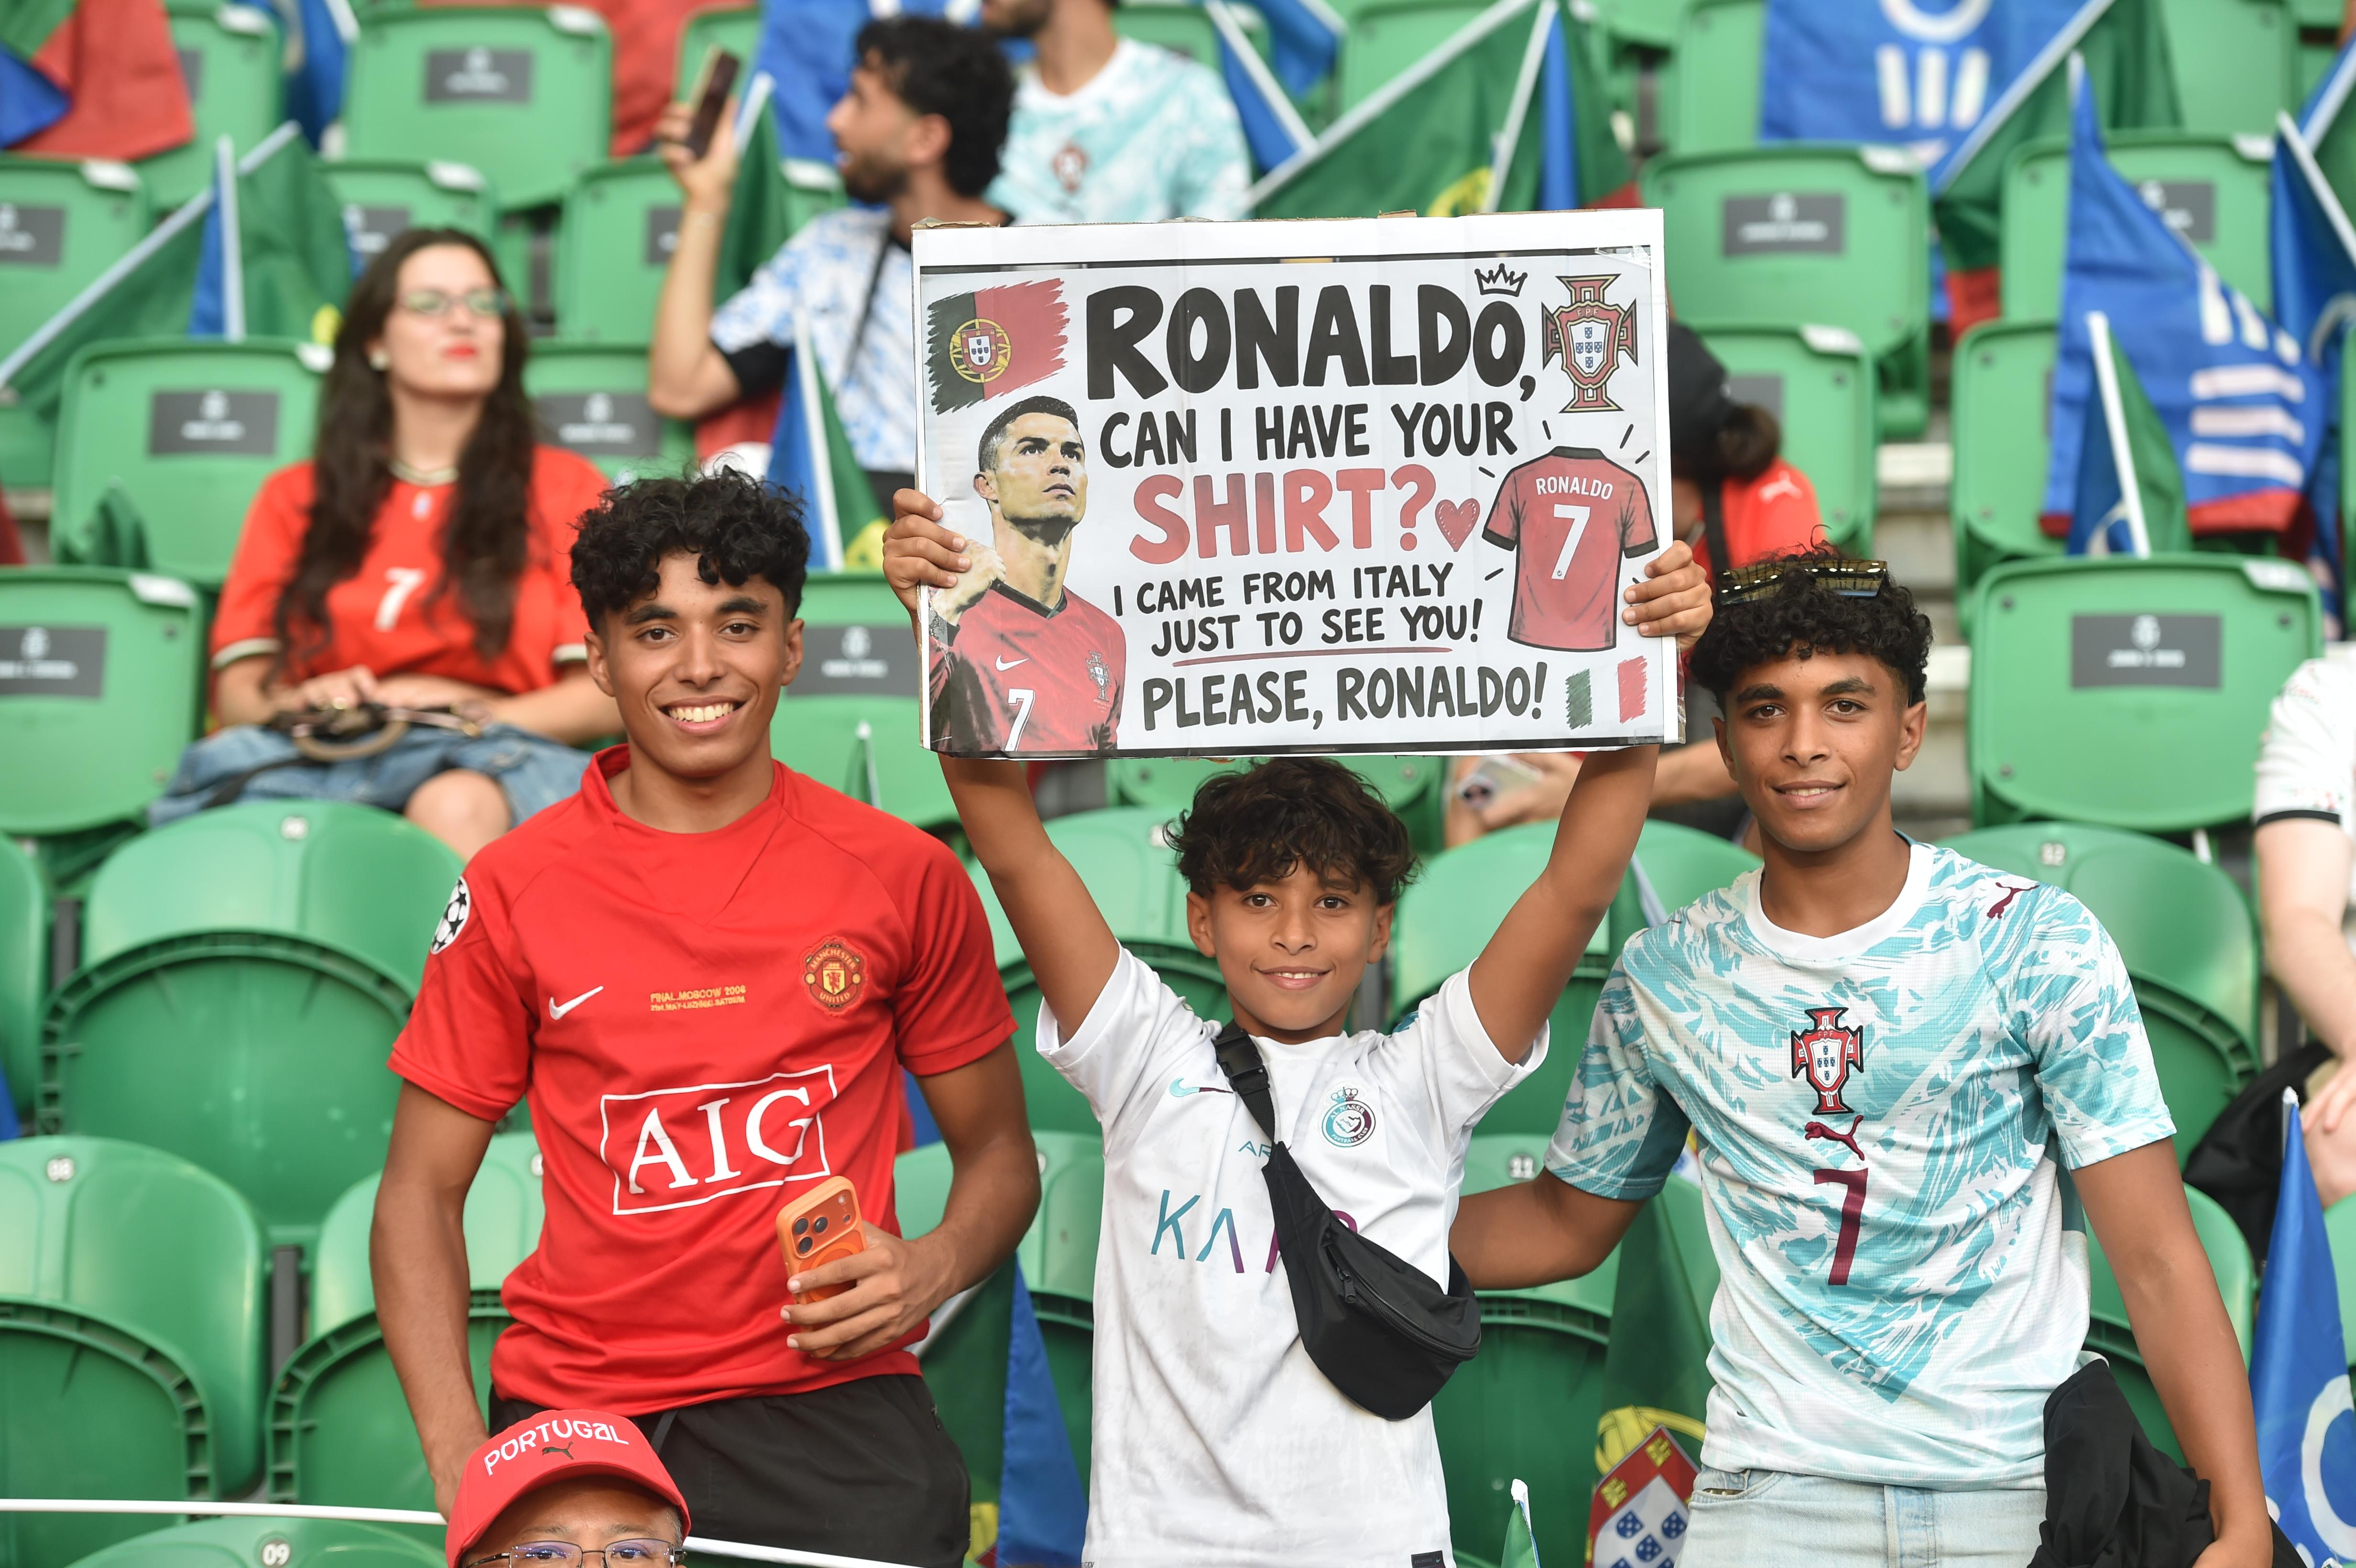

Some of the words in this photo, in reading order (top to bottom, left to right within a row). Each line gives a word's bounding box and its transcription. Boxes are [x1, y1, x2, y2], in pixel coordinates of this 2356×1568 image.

[1087, 285, 1536, 401] RONALDO,
[1100, 409, 1197, 468] CAN
[1221, 408, 1232, 462] I
[1255, 403, 1370, 460] HAVE
[1390, 401, 1518, 457] YOUR
[1129, 464, 1436, 564] SHIRT?
[1536, 476, 1613, 500] RONALDO
[1551, 504, 1590, 580] 7
[373, 566, 427, 632] 7
[1114, 586, 1123, 617] I
[1136, 576, 1224, 614] CAME
[1243, 569, 1335, 605] FROM
[1353, 562, 1454, 599] ITALY
[1151, 615, 1240, 656] JUST
[1256, 611, 1303, 646] TO
[1321, 607, 1385, 644] SEE
[1400, 598, 1483, 642] YOU!
[1005, 688, 1035, 751] 7
[1143, 670, 1323, 730] PLEASE,
[1337, 662, 1547, 721] RONALDO!
[724, 985, 746, 996] 2008
[810, 948, 856, 969] MANCHESTER
[819, 992, 851, 1002] UNITED
[628, 1086, 813, 1194] AIG
[1813, 1168, 1868, 1285] 7
[262, 1544, 290, 1566] 09
